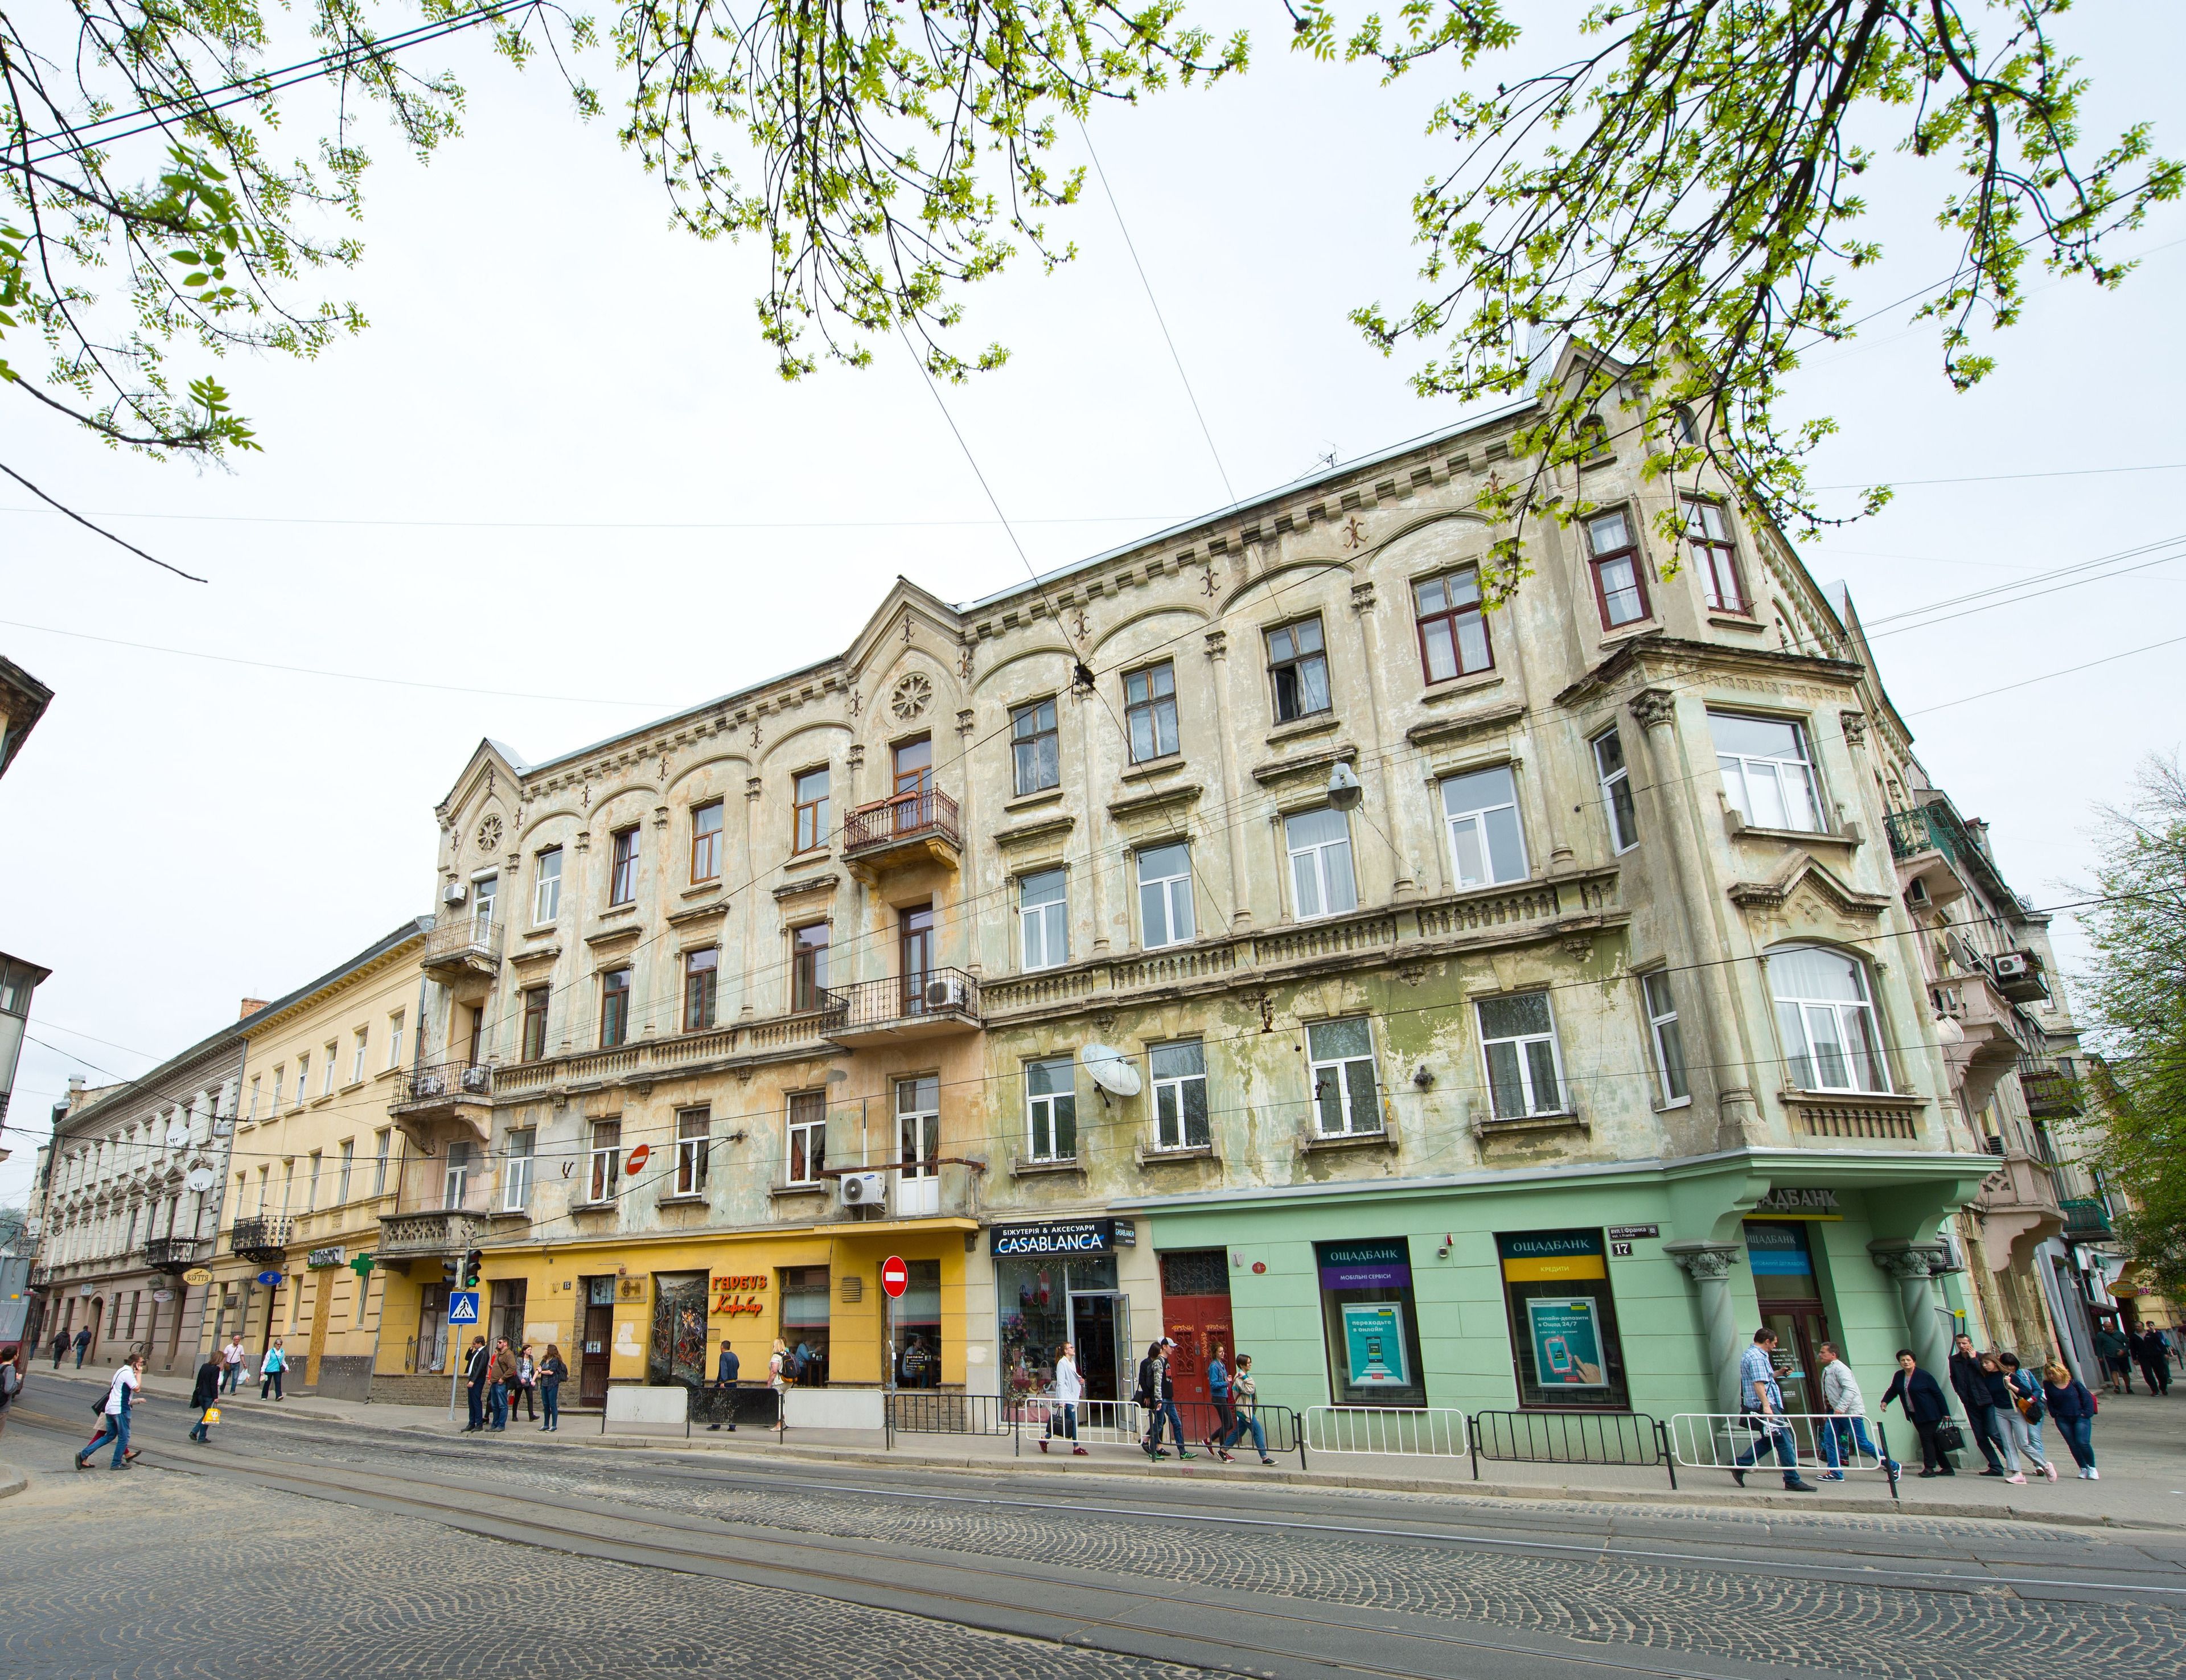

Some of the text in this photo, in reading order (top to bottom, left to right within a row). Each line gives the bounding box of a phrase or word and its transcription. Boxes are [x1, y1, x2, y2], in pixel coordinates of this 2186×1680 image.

[1758, 1189, 1840, 1210] АДБАНК
[1003, 1227, 1039, 1236] БІЖУТЕРІЯ
[1051, 1225, 1095, 1233] АКСЕСУАРИ
[999, 1233, 1103, 1253] CASABLANCA
[1513, 1239, 1590, 1252] ОЩАДБАНК
[1615, 1243, 1628, 1254] 17
[1330, 1250, 1398, 1262] ОЩАДБАНК
[712, 1275, 767, 1290] ГАРБУЗ
